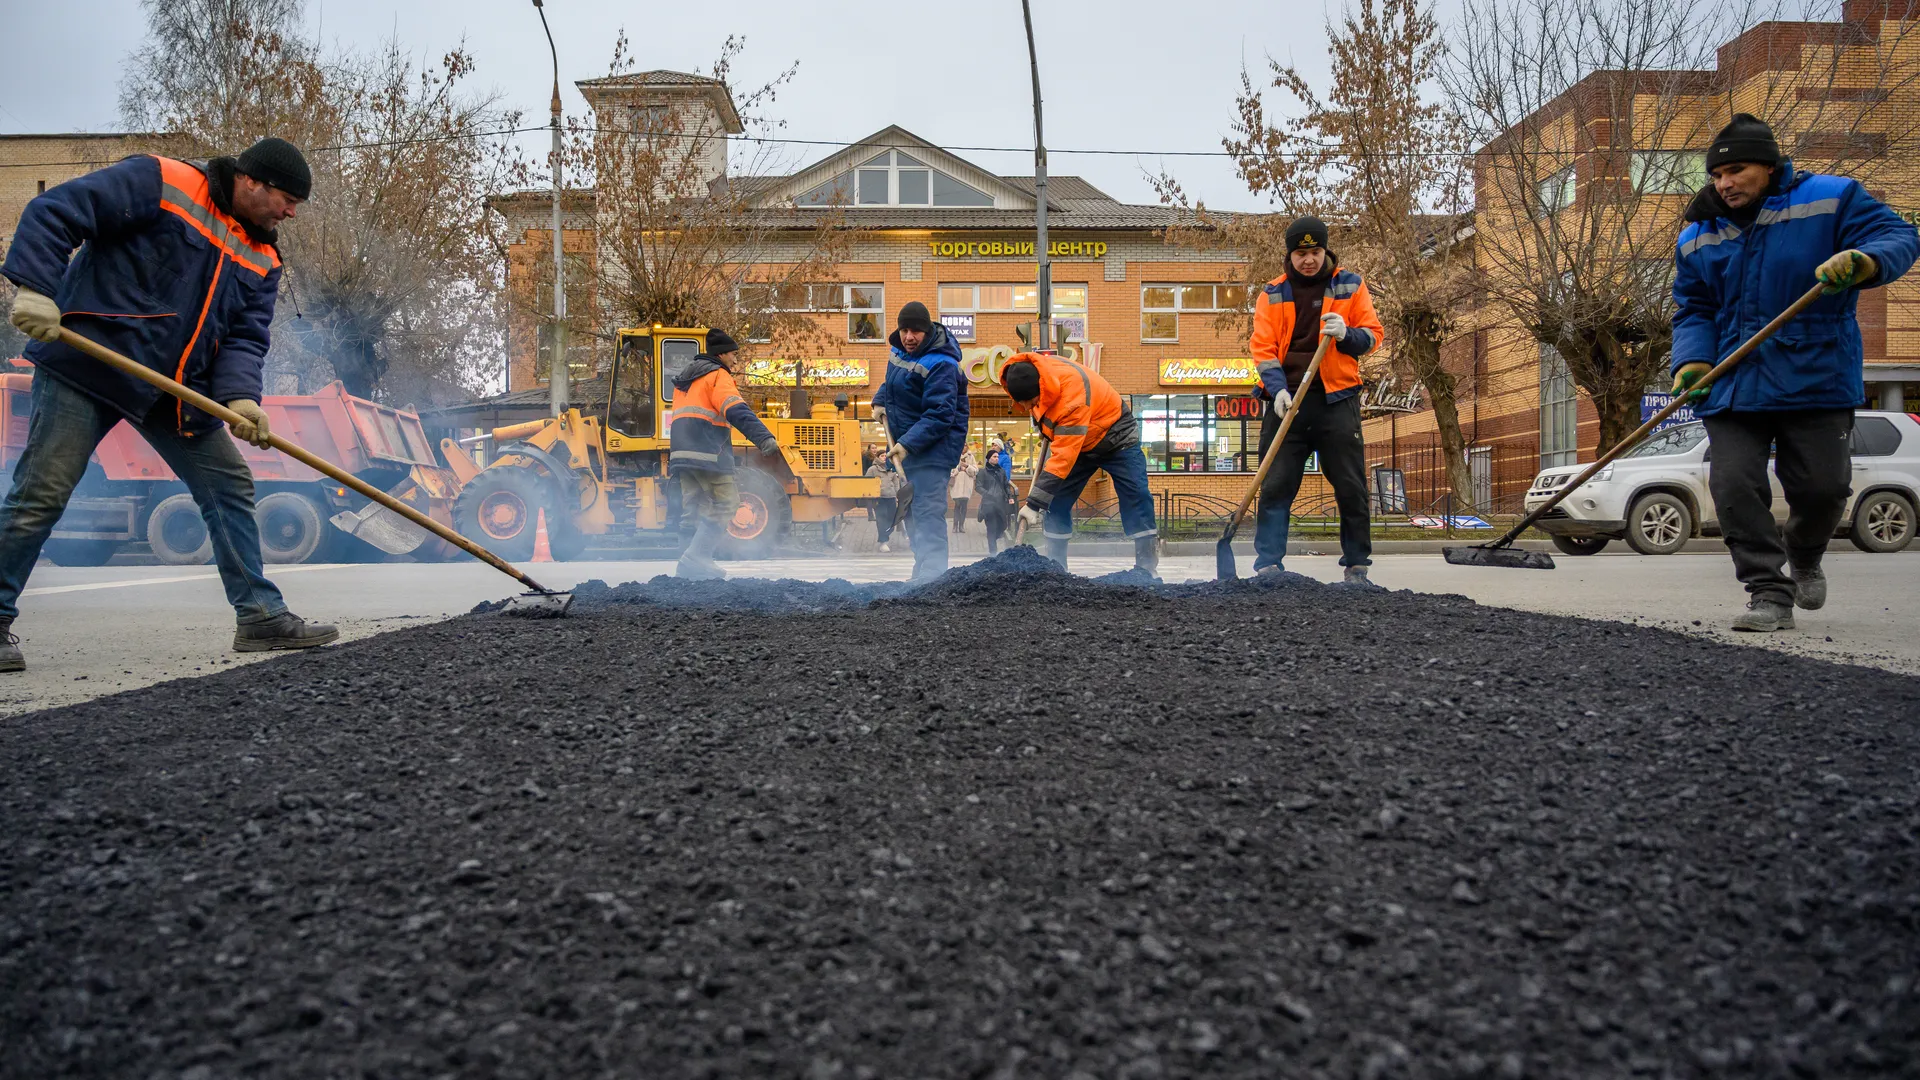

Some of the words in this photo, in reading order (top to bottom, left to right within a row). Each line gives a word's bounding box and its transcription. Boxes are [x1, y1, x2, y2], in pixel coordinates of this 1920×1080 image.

[929, 241, 1034, 258] торговый
[941, 316, 973, 326] КОВРЫ
[1163, 362, 1249, 383] Кулинария
[1217, 398, 1259, 417] ФОТО
